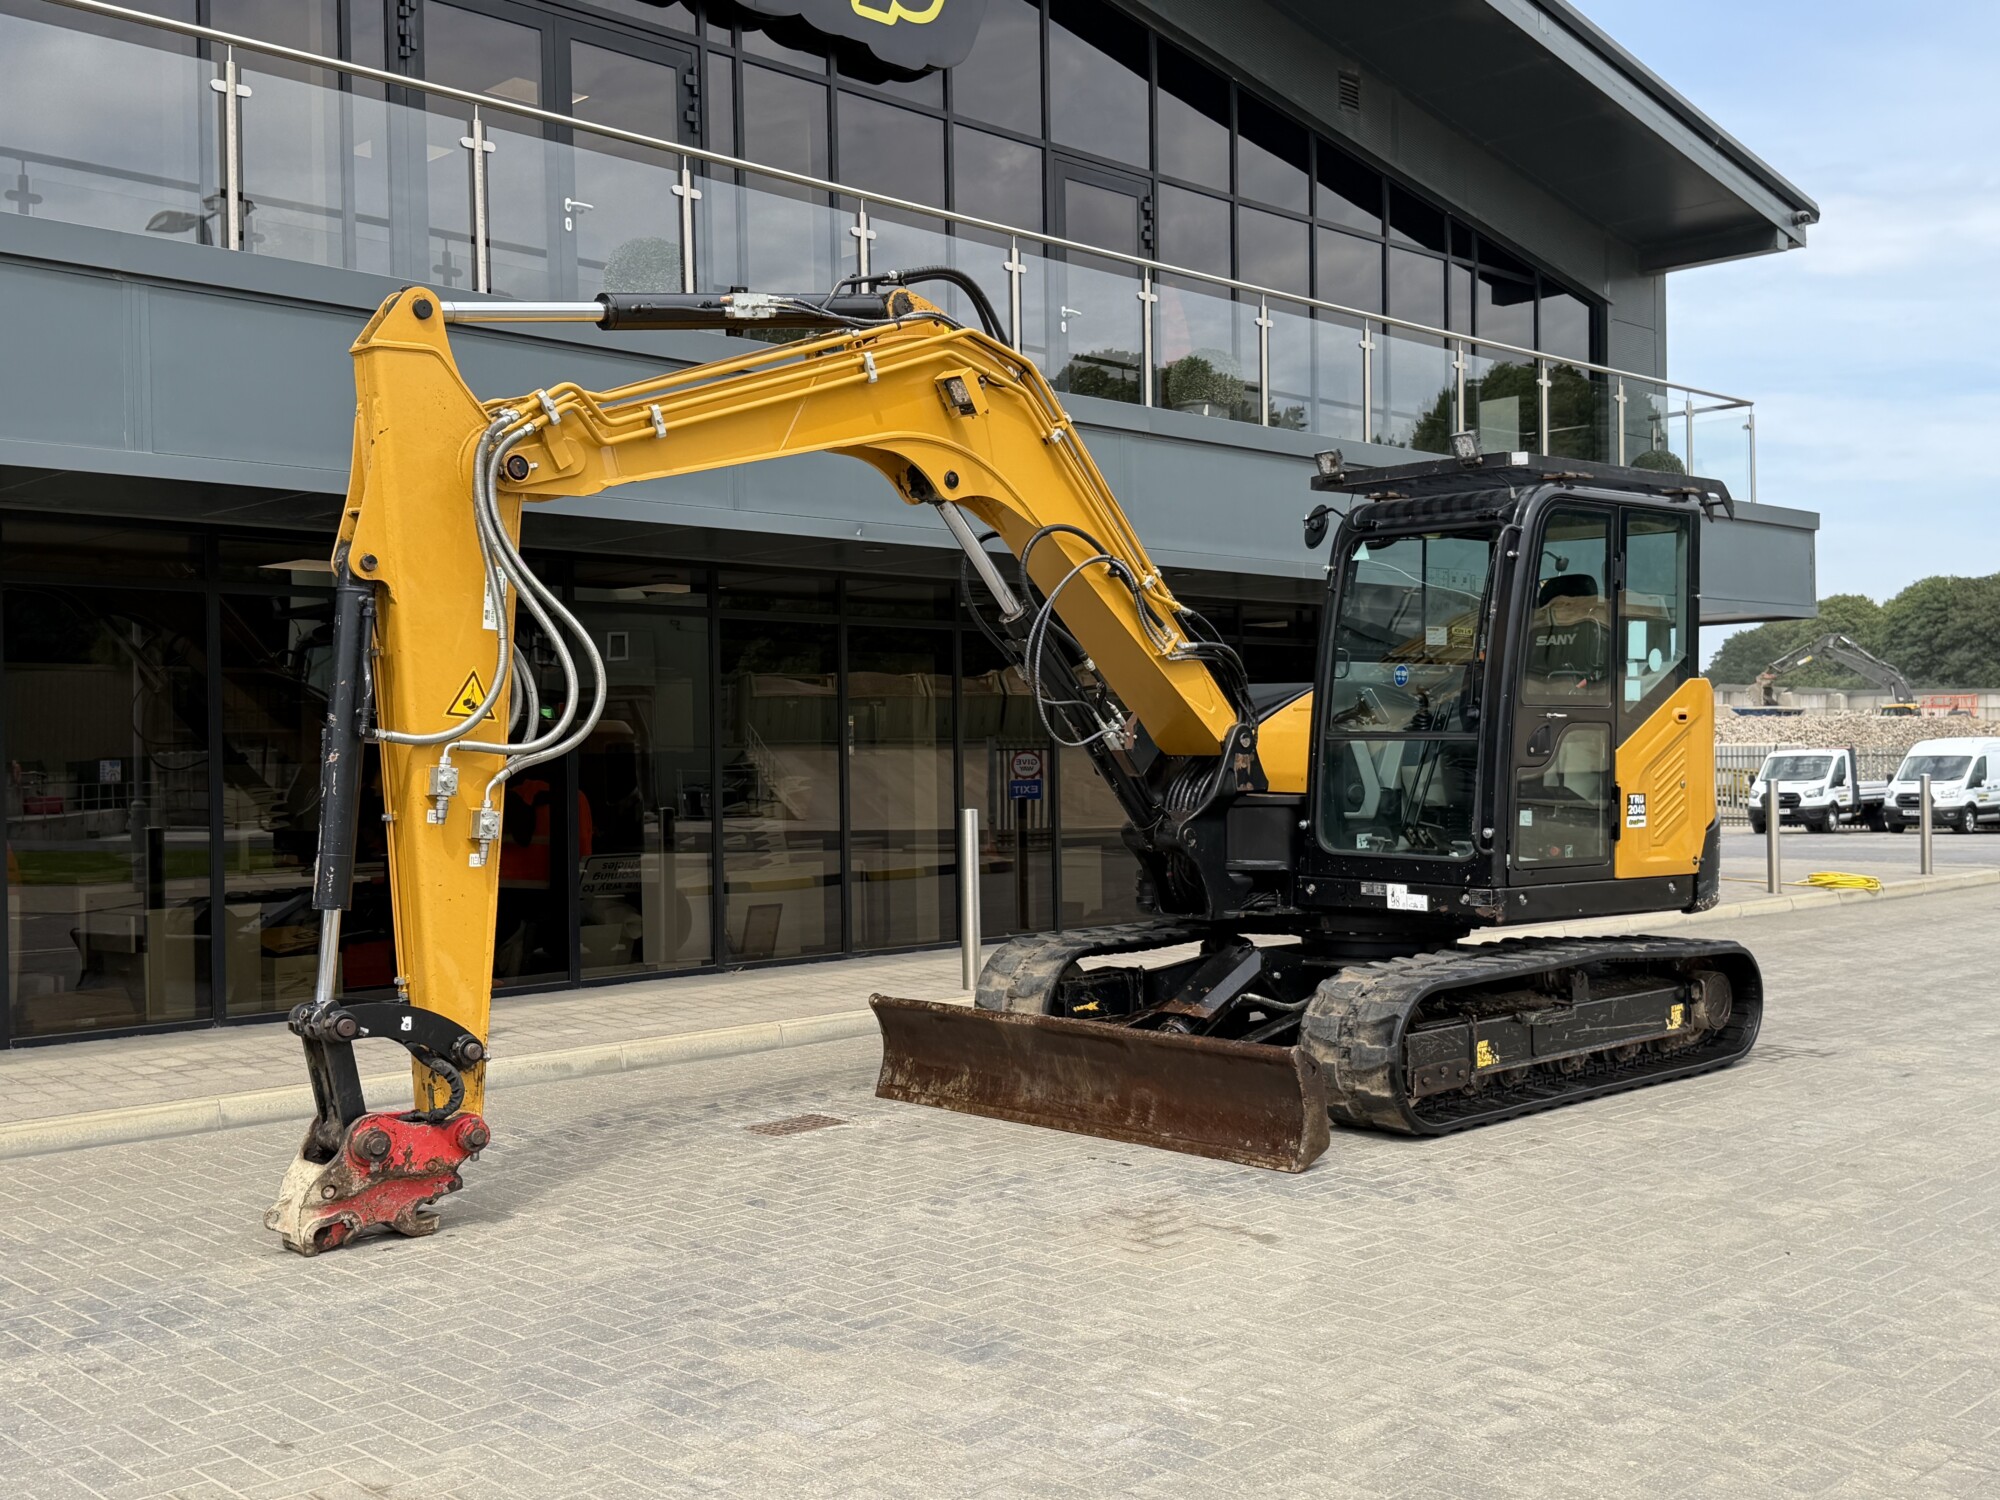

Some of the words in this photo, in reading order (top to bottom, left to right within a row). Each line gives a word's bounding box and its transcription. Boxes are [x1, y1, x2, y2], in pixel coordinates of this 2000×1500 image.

[1535, 633, 1577, 646] SANY
[1628, 794, 1645, 805] TRU
[1627, 805, 1646, 815] 2040
